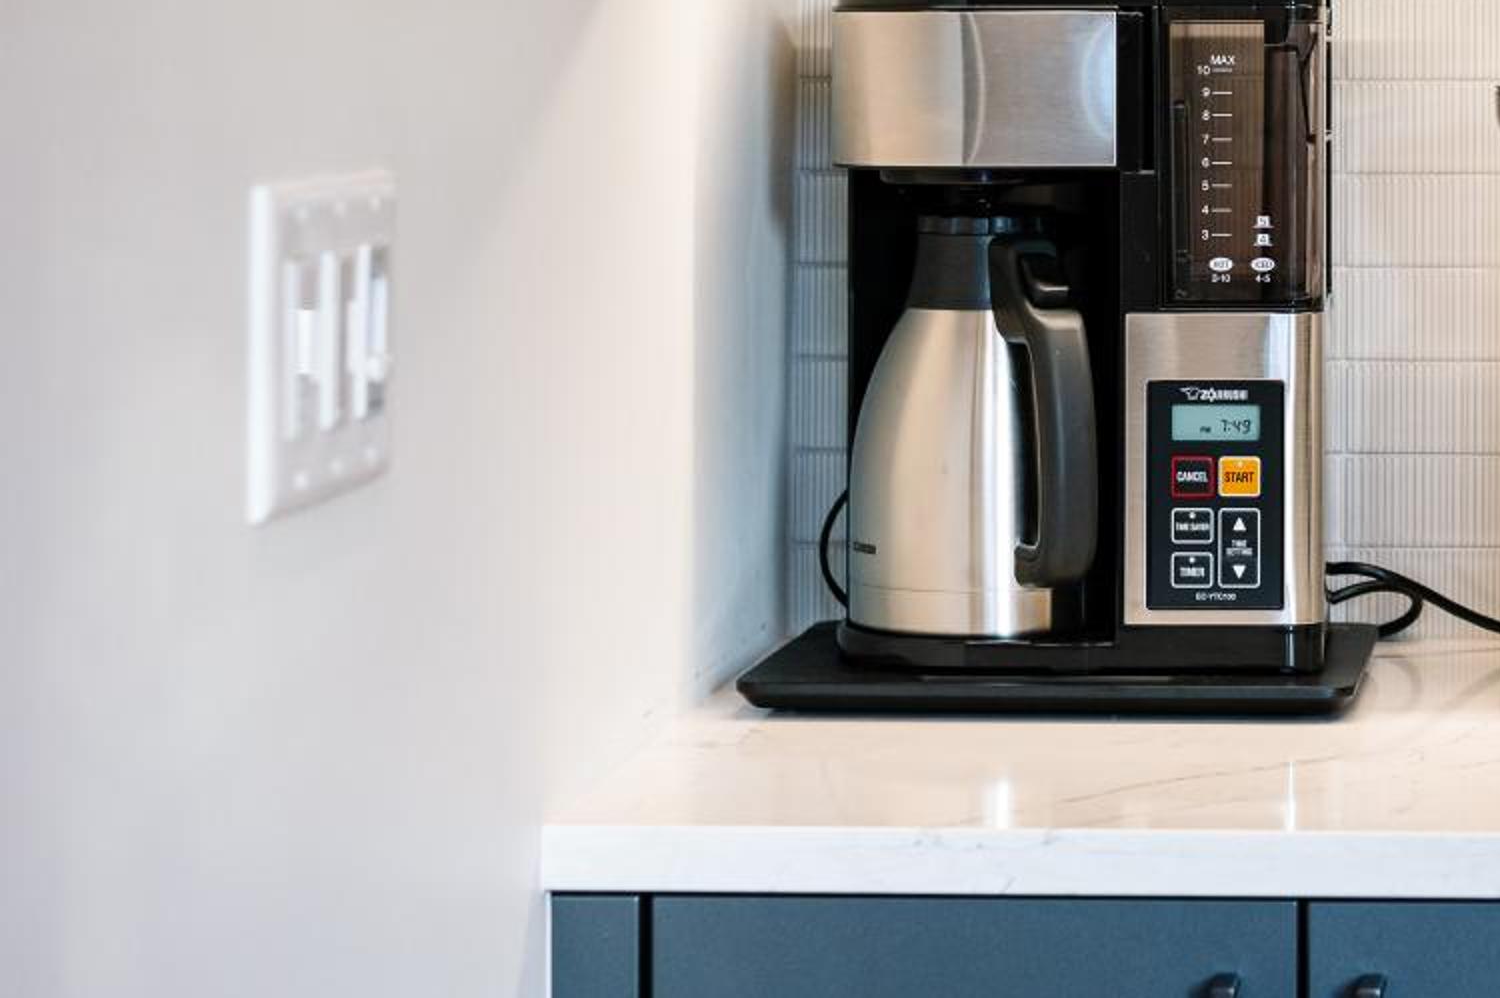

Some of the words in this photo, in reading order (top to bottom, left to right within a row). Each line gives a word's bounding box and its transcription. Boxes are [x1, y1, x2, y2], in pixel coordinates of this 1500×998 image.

[1209, 54, 1236, 65] MAX
[1197, 65, 1211, 75] 10
[1201, 87, 1211, 98] 9
[1201, 109, 1211, 121] 8
[1202, 133, 1210, 145] 7
[1201, 156, 1210, 168] 6
[1201, 180, 1209, 191] 5
[1201, 204, 1209, 215] 4
[1201, 229, 1209, 241] 3
[1220, 419, 1252, 434] 7:49
[1176, 471, 1208, 483] CANCEL
[1224, 471, 1255, 483] START
[1180, 567, 1205, 578] TIMER
